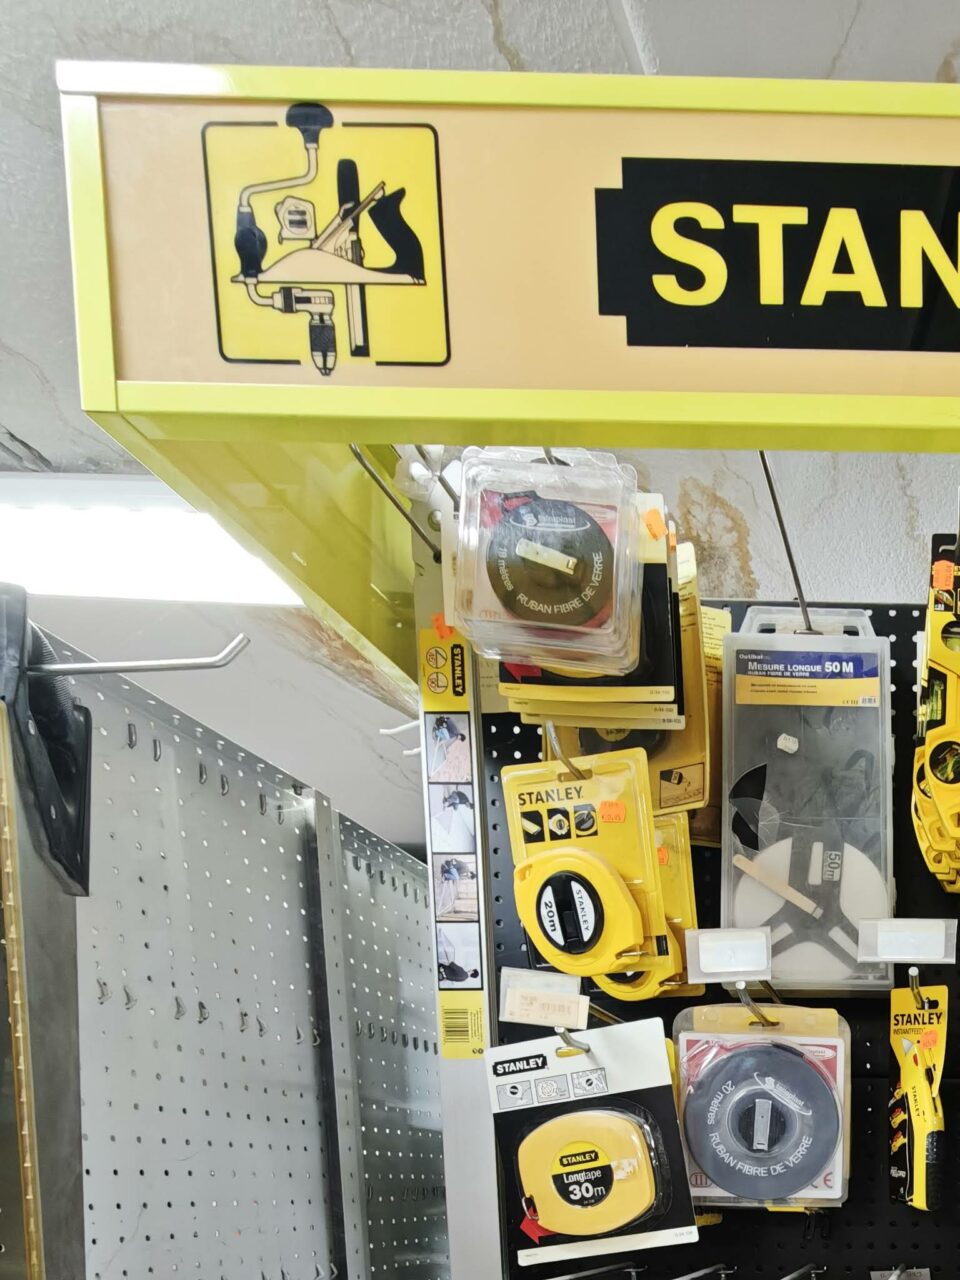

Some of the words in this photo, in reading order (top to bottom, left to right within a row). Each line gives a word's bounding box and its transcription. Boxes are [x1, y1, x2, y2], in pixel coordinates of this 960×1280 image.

[516, 592, 552, 615] RUBAN
[553, 596, 584, 615] FIBRE
[581, 587, 596, 602] DE
[590, 551, 604, 587] VERRE
[453, 646, 463, 694] STANLEY
[748, 661, 785, 671] MESURE
[787, 664, 822, 672] LONGUE
[824, 661, 841, 673] 50
[842, 662, 854, 673] M
[517, 786, 584, 806] STANLEY
[824, 852, 842, 882] 50m
[544, 900, 557, 933] 20m
[575, 889, 590, 932] STANLEY
[894, 1012, 943, 1026] STANLEY
[496, 1057, 544, 1074] STANLEY
[562, 1152, 597, 1166] STANLEY
[709, 1132, 738, 1169] RUBAN
[736, 1162, 769, 1177] FIBRE
[770, 1162, 787, 1174] DE
[785, 1135, 813, 1168] VERRE
[563, 1169, 602, 1183] Longtape
[568, 1182, 606, 1200] 30m
